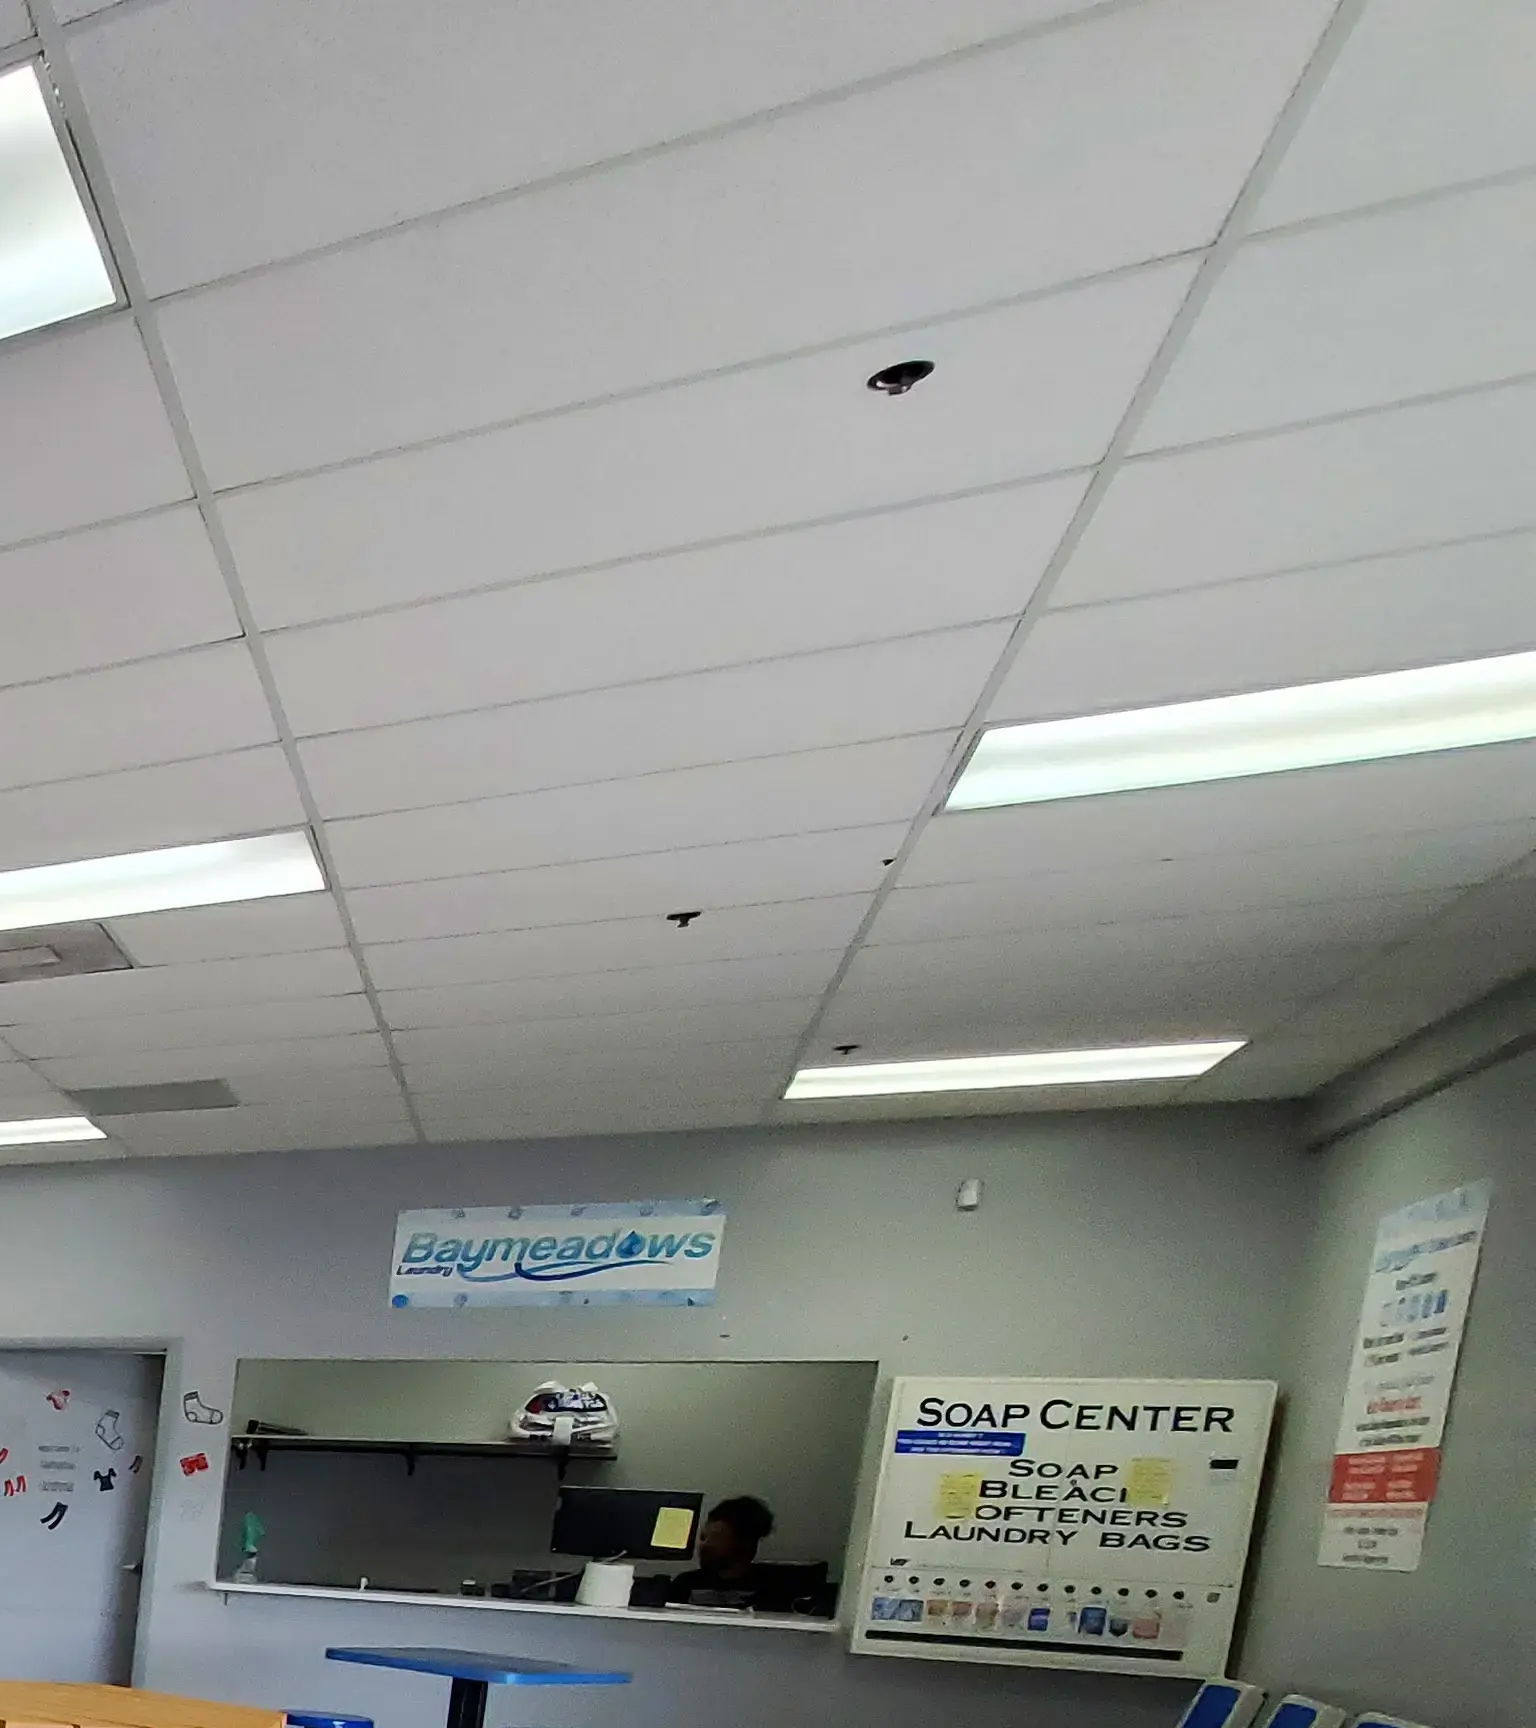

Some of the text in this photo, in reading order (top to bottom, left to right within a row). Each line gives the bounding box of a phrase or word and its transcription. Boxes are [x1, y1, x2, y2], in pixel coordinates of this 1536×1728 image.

[401, 1230, 717, 1271] Baymeadows
[916, 1397, 1235, 1433] SOAP CENTER
[1009, 1459, 1119, 1480] SOAP
[945, 1504, 1189, 1528] OFTENERS
[903, 1521, 1212, 1552] LAUNDRY BAGS
